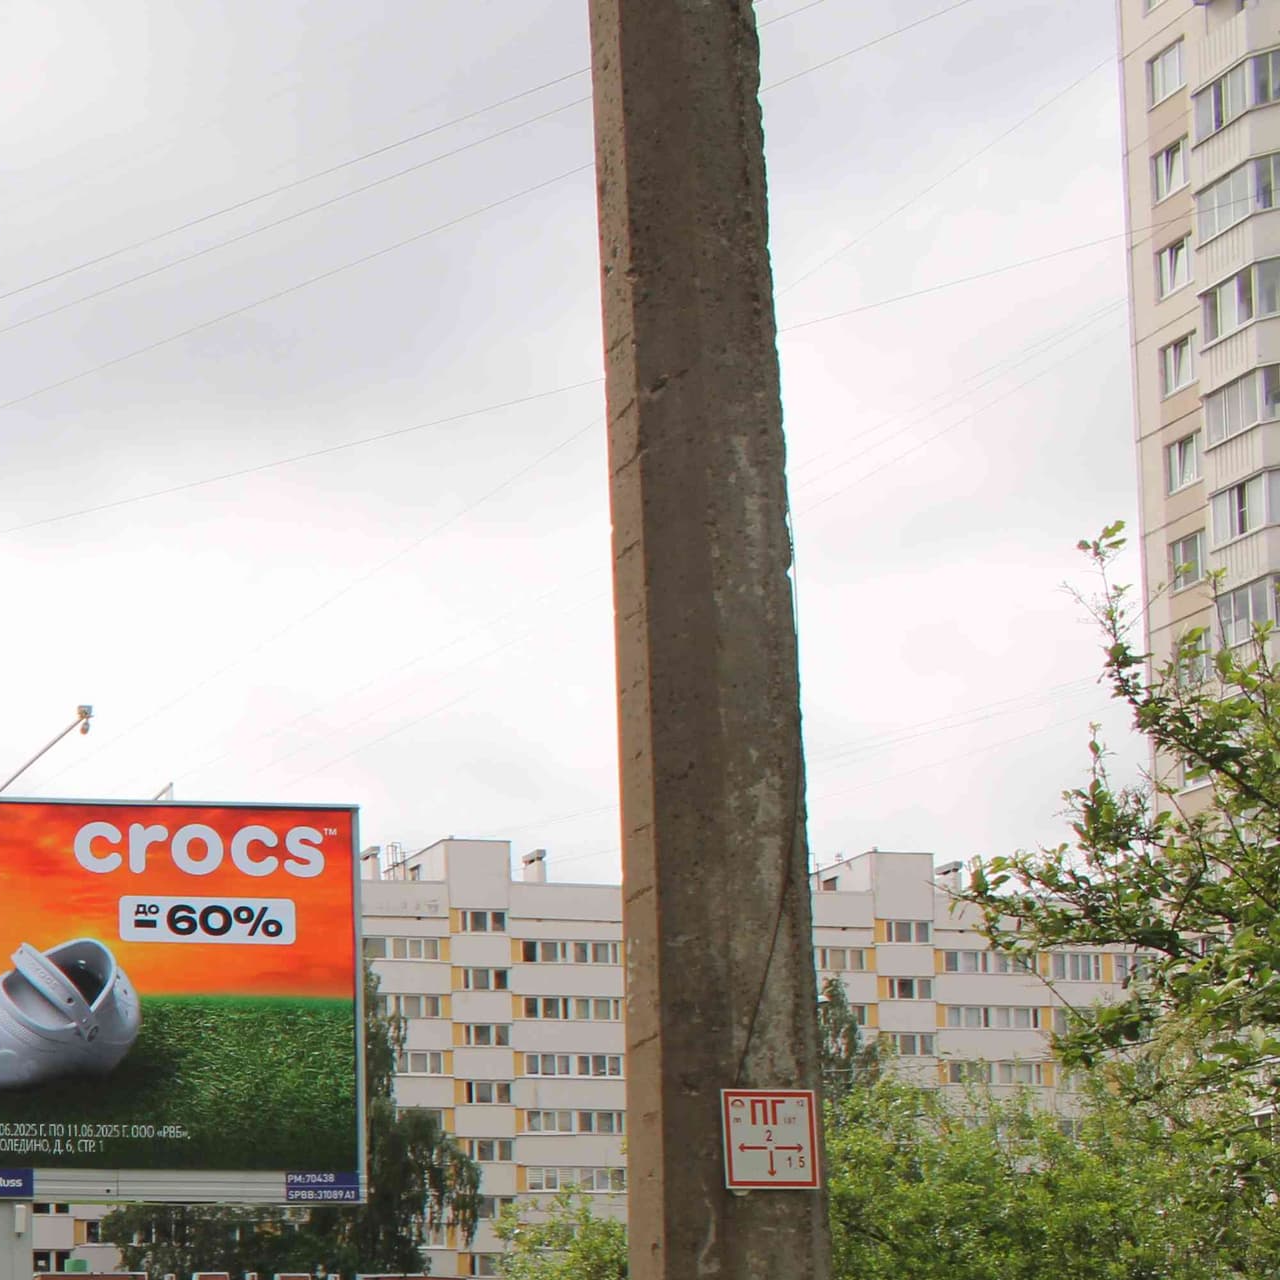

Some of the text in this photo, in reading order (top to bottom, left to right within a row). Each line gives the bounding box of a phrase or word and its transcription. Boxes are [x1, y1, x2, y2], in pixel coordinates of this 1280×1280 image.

[73, 821, 325, 878] crocs
[750, 1099, 785, 1125] ПГ
[48, 1125, 65, 1138] ПО
[765, 1129, 773, 1142] 2
